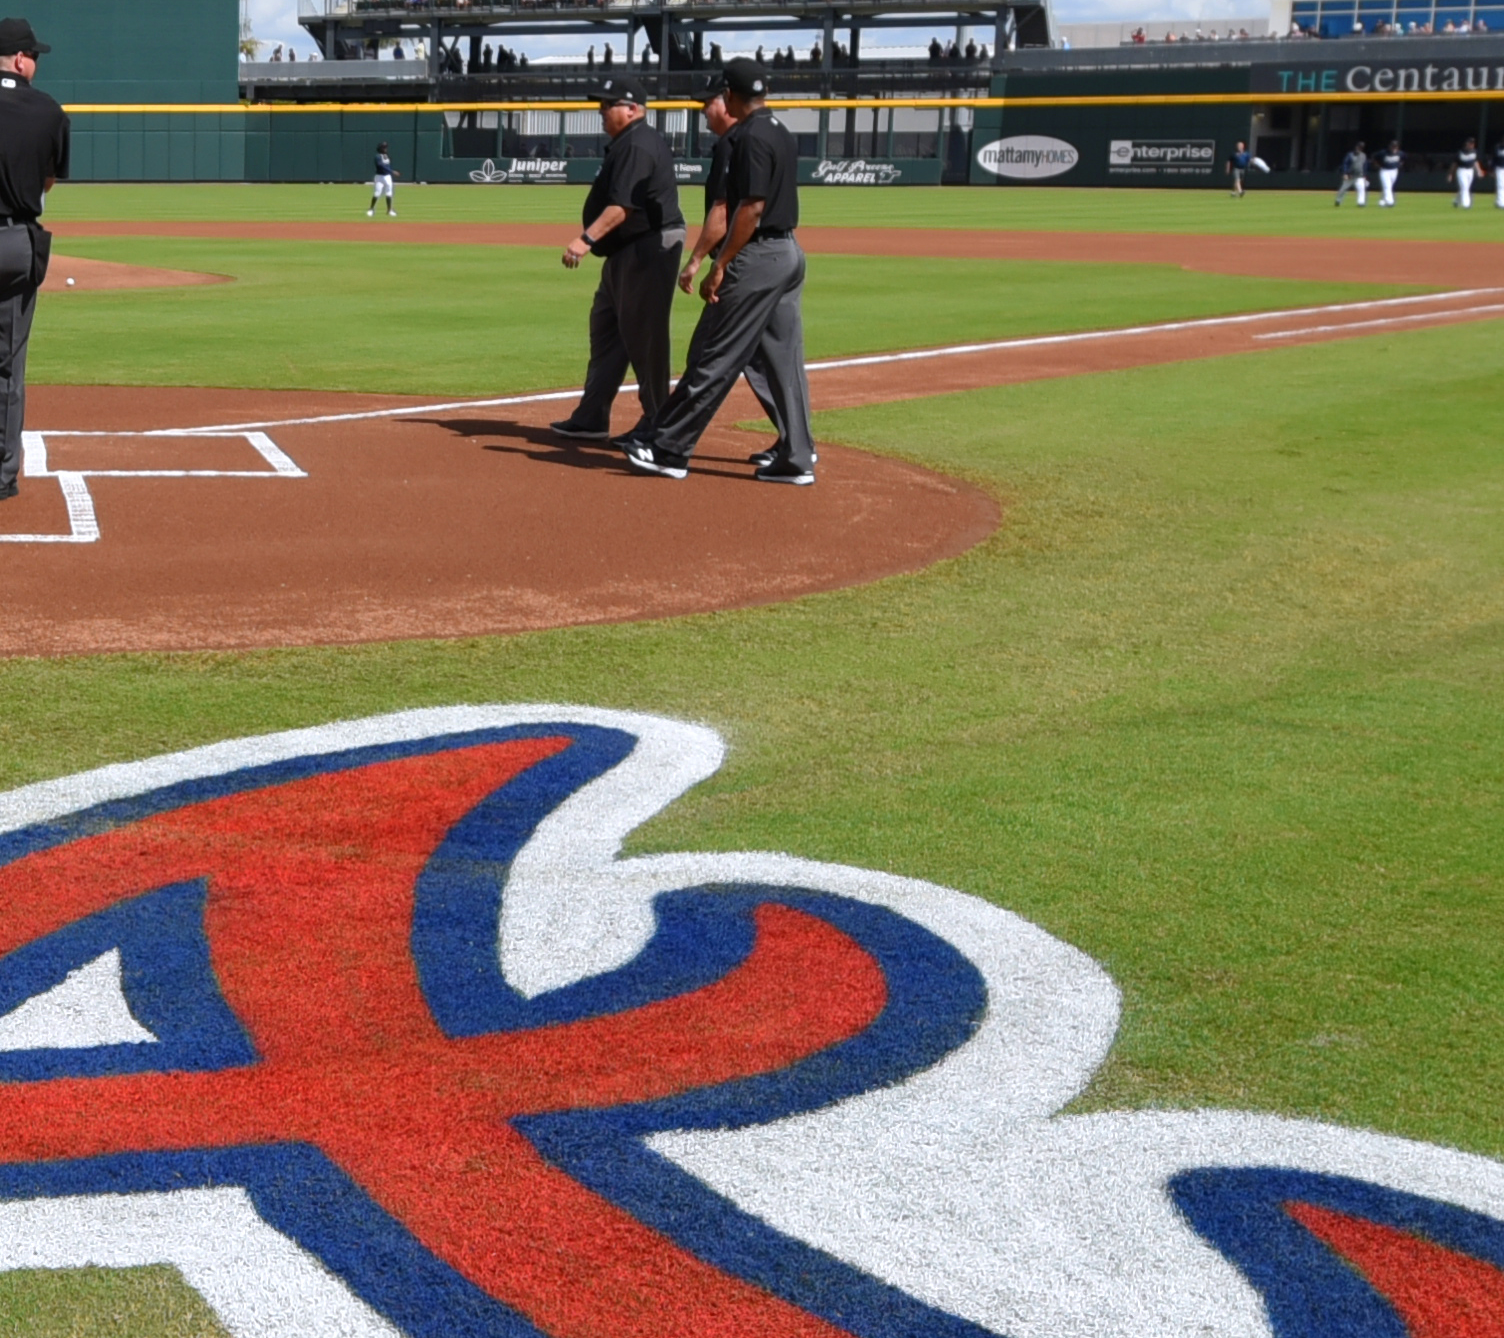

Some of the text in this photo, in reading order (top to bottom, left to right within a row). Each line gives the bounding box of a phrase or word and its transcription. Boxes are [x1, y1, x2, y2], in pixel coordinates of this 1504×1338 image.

[1278, 70, 1338, 92] THE
[1112, 144, 1213, 162] enterprise
[507, 157, 568, 174] Juniper
[824, 172, 876, 183] APPAREL
